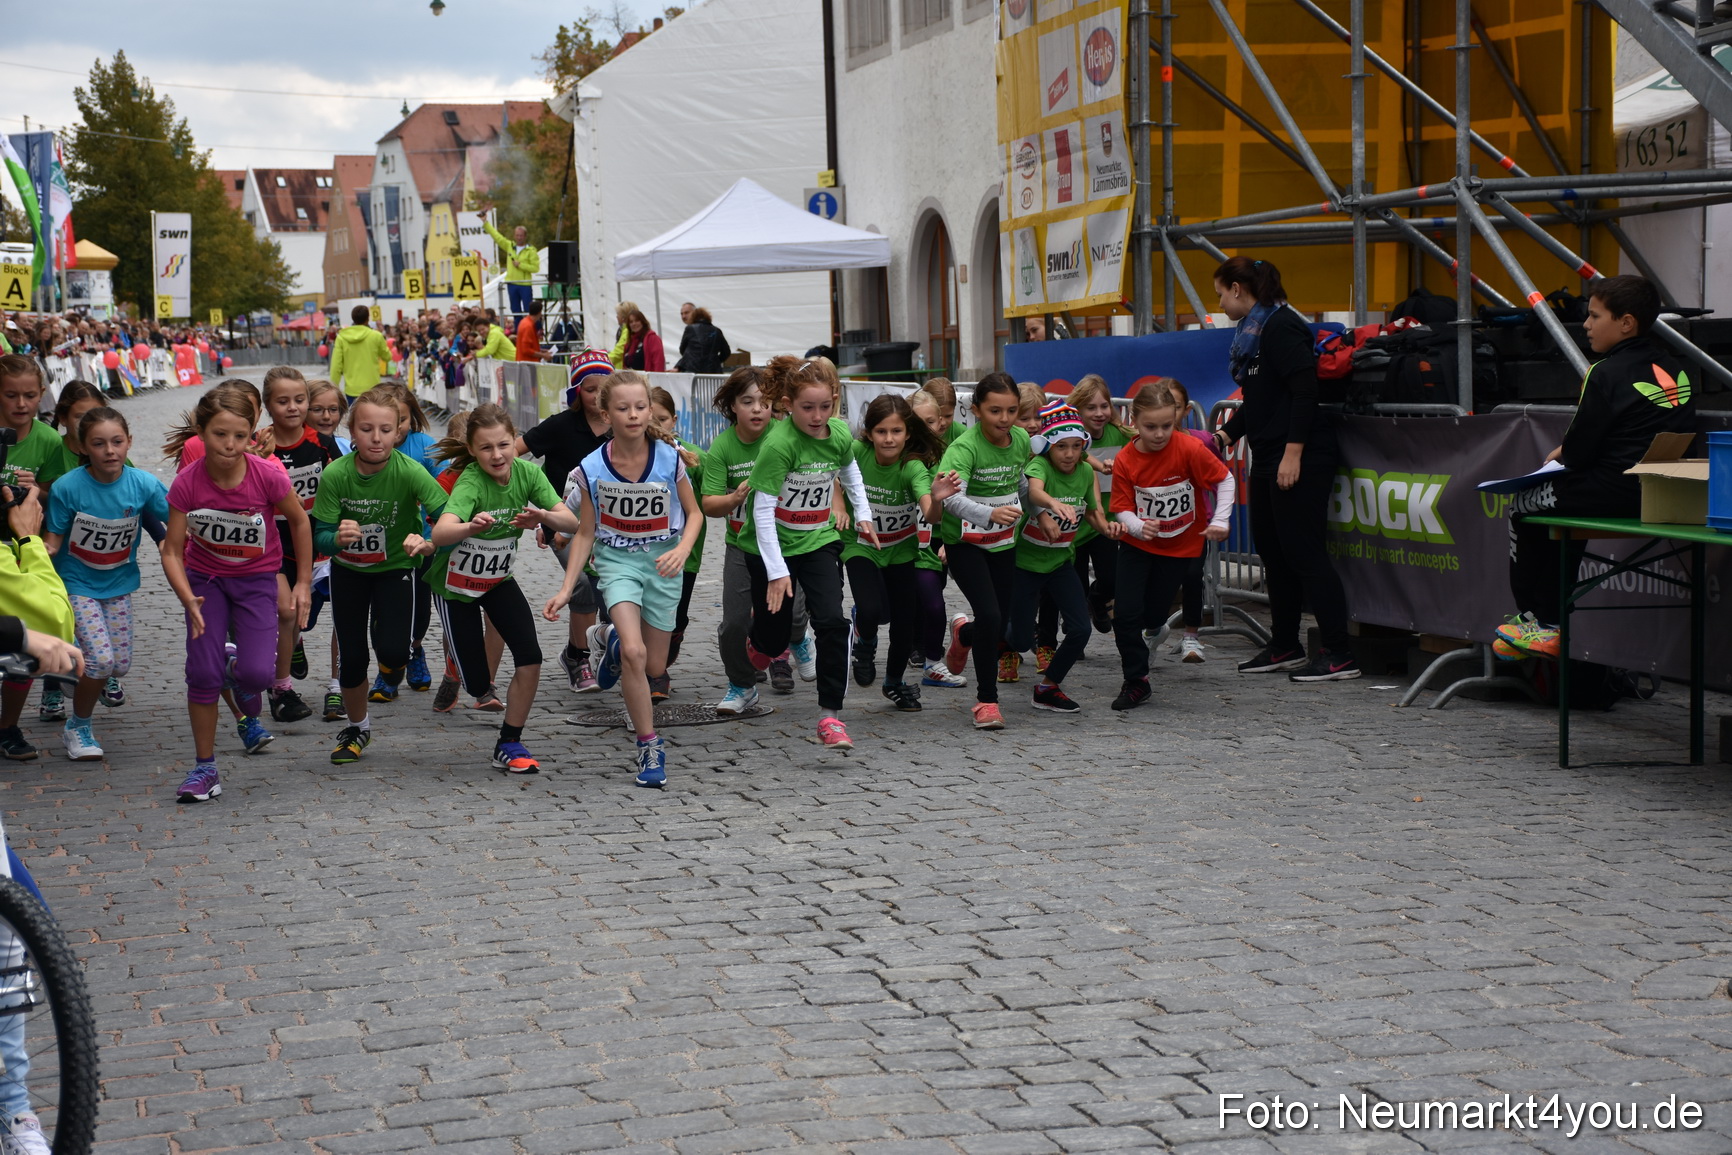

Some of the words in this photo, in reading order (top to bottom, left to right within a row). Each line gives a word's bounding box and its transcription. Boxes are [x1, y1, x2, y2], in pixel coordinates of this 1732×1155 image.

[1087, 42, 1113, 70] Hervis
[1637, 126, 1658, 167] 63
[1665, 120, 1688, 164] 52
[1096, 161, 1122, 175] Neumarkter
[1092, 175, 1128, 193] Lammsbräu
[159, 229, 188, 239] swn
[3, 265, 29, 275] Block
[455, 258, 478, 267] Block
[1047, 250, 1070, 273] swn
[6, 278, 24, 301] A
[409, 279, 420, 293] B
[460, 270, 476, 291] A
[160, 301, 168, 313] C
[728, 460, 755, 471] Neumark
[293, 476, 318, 498] 29
[599, 484, 621, 494] PARTL
[623, 487, 658, 495] Neumarkt
[1156, 487, 1185, 498] Neumarkt
[785, 484, 831, 509] 7131
[1326, 474, 1444, 535] BOCK
[604, 495, 664, 518] 7026
[1143, 493, 1190, 519] 7228
[76, 517, 99, 528] PARTL
[101, 522, 132, 530] Neumarkt
[216, 516, 253, 527] Neumarkt
[615, 521, 652, 531] Theresa
[790, 513, 818, 524] Sophia
[872, 514, 911, 532] 122
[80, 526, 134, 551] 7575
[195, 520, 259, 544] 7048
[345, 534, 380, 551] 46
[458, 549, 512, 576] 7044
[1366, 540, 1377, 564] by
[1380, 547, 1406, 565] smart
[1408, 552, 1460, 574] concepts
